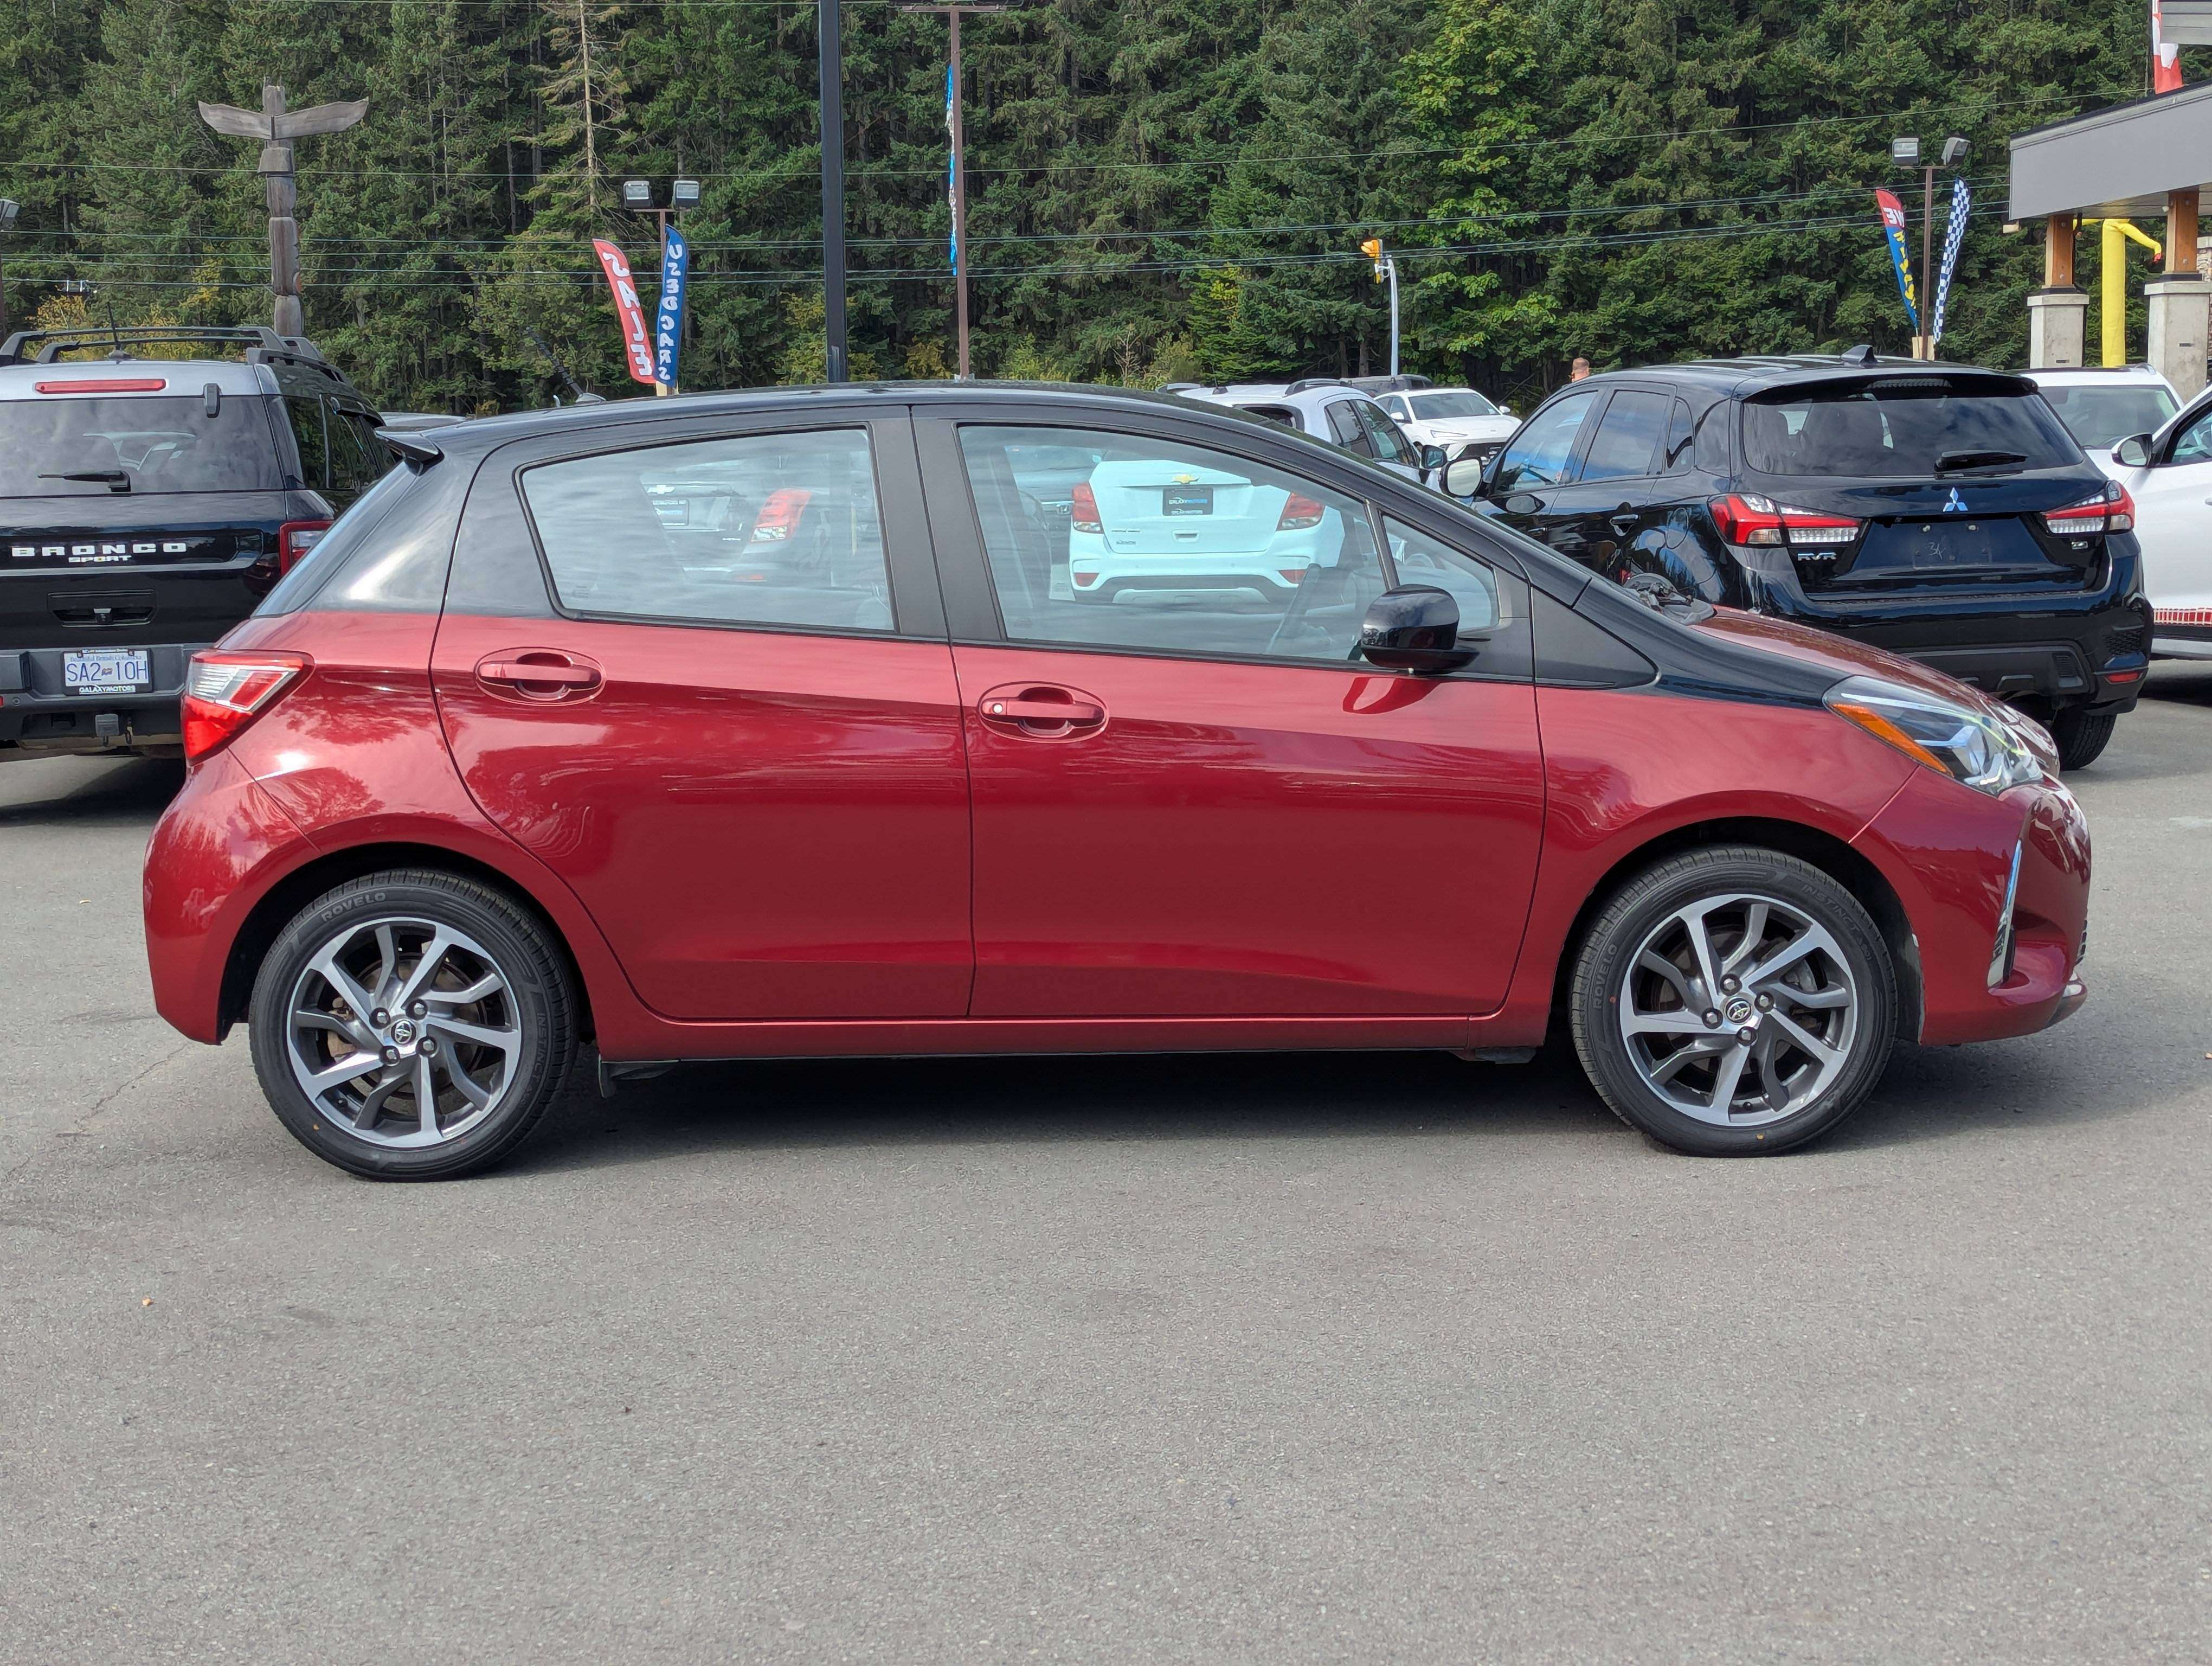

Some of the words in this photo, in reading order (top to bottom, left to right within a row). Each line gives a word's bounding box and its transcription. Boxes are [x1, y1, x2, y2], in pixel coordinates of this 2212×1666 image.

[11, 543, 187, 556] BRONCO
[1797, 552, 1837, 561] RVR
[67, 662, 101, 682] SA2
[321, 892, 386, 921] ROVELO
[1593, 944, 1617, 1009] ROVELO
